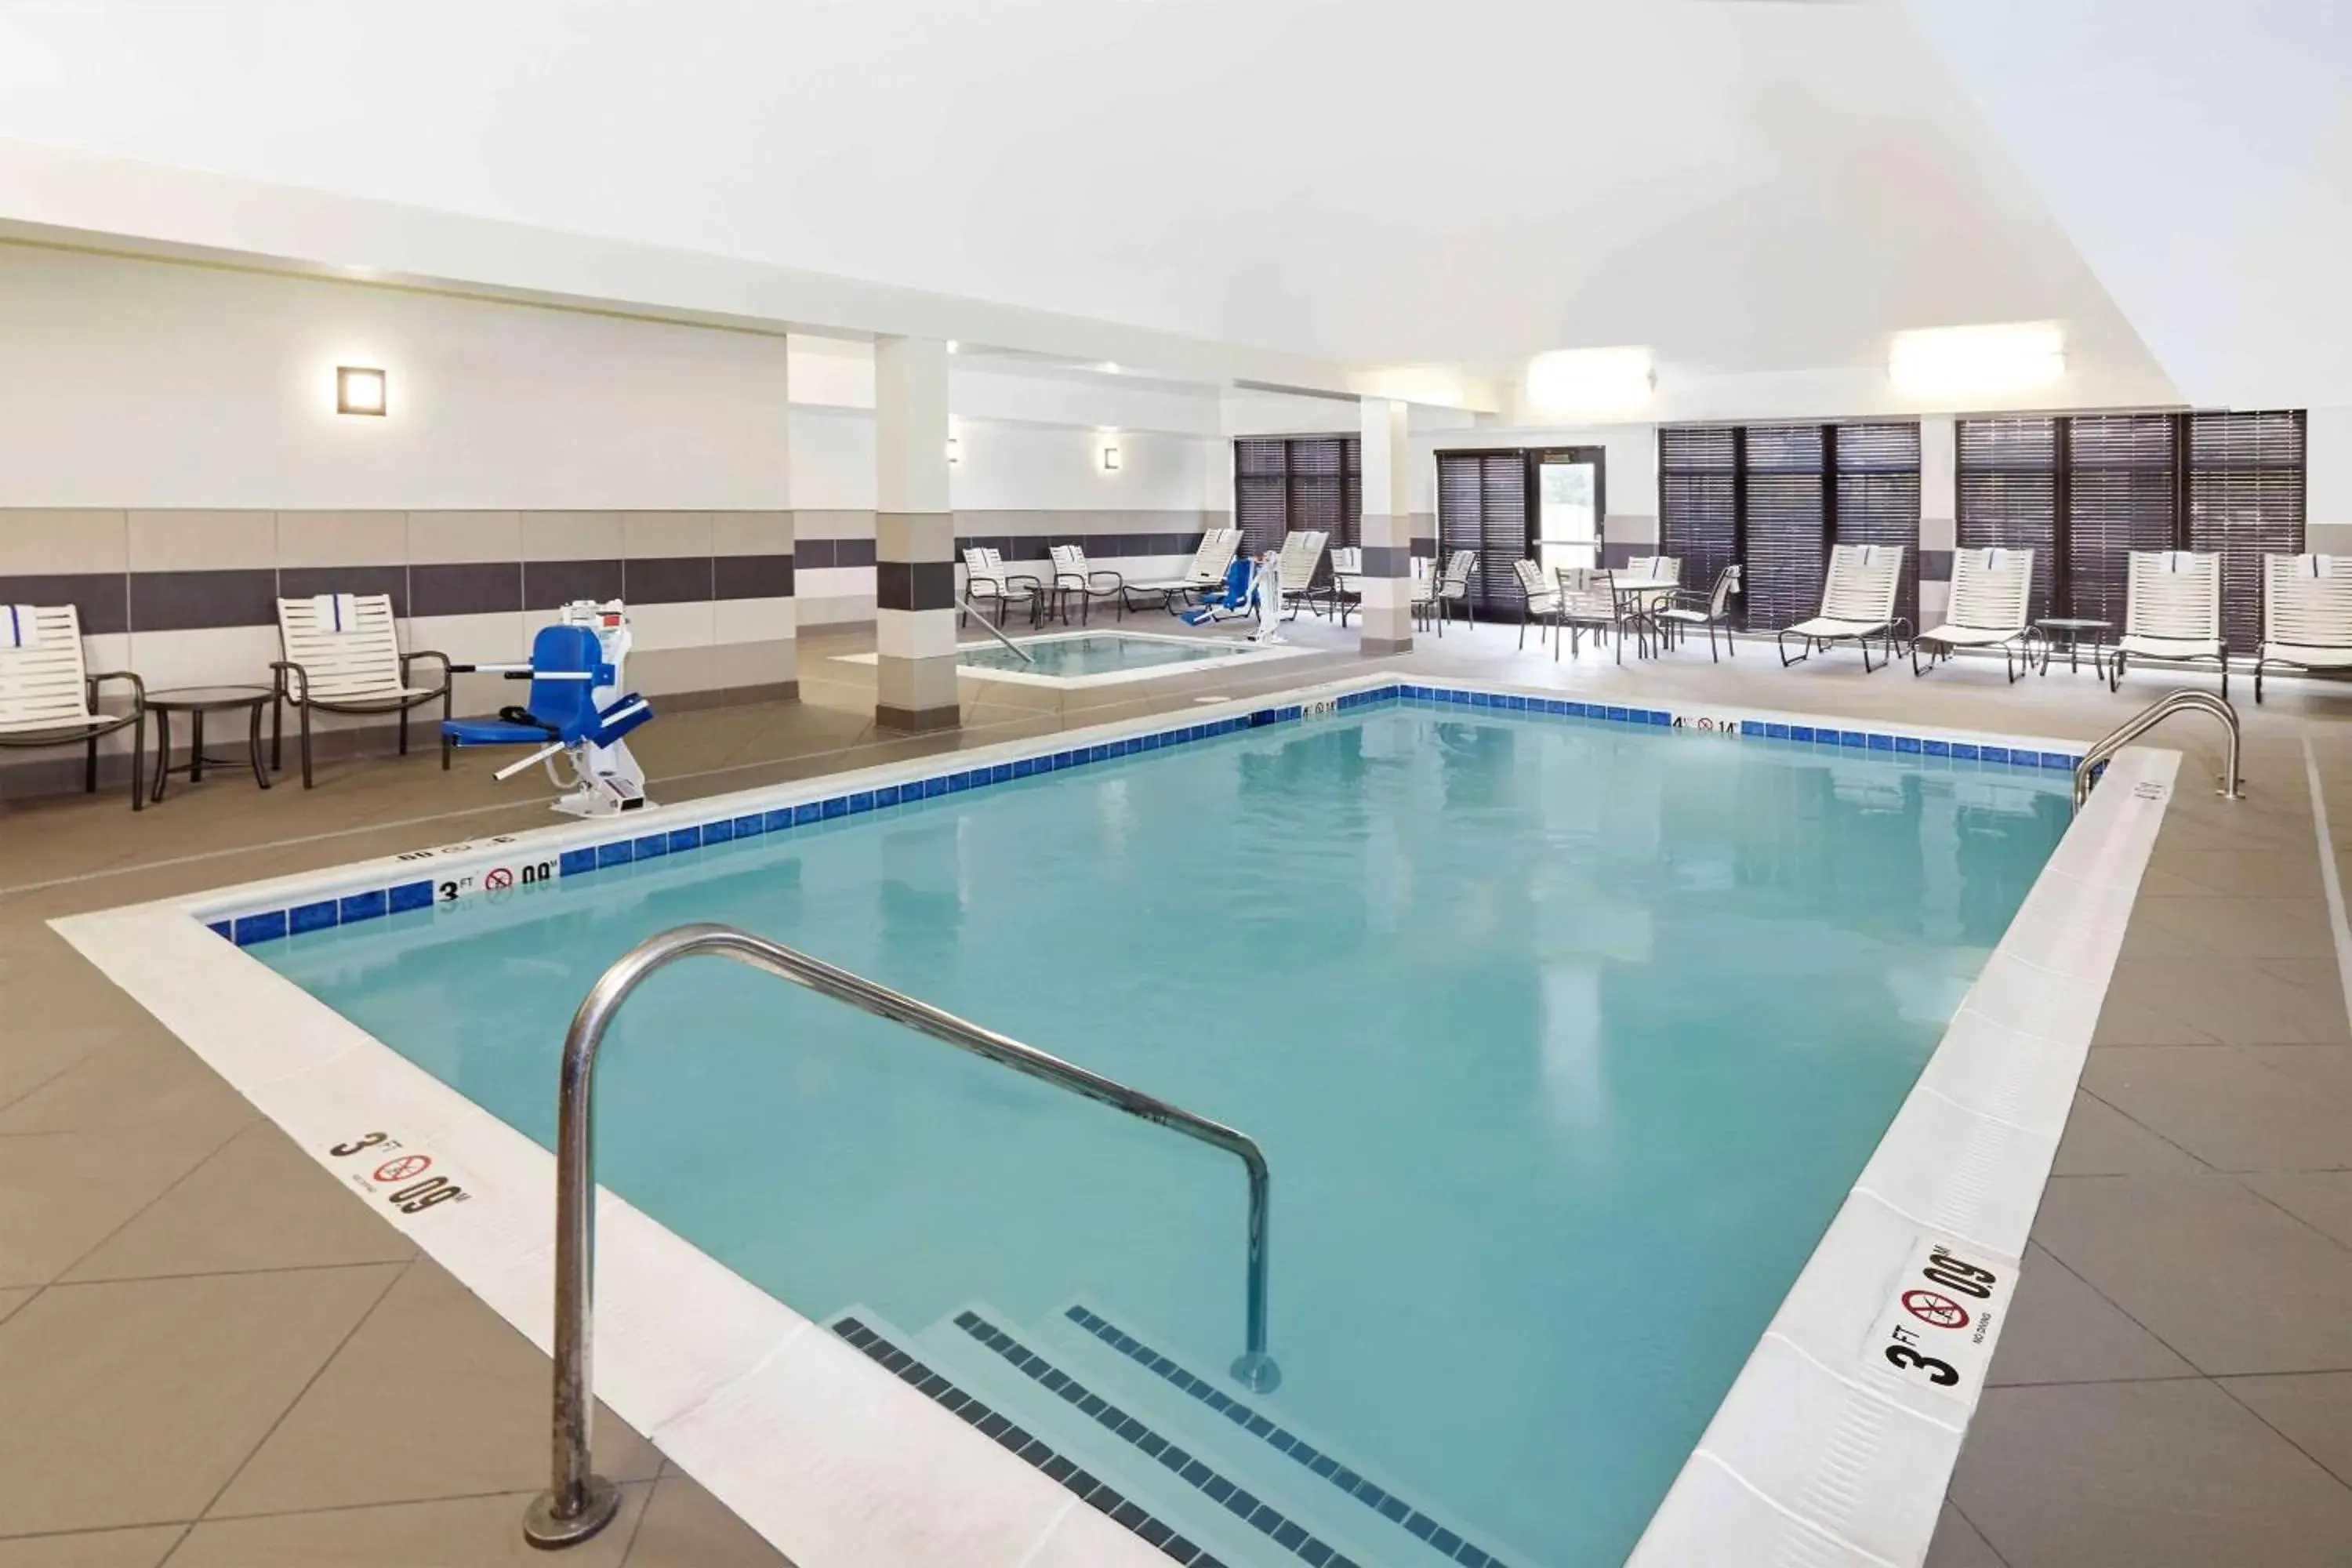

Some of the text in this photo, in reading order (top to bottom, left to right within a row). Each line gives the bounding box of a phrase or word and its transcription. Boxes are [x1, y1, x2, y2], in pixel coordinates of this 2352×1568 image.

[439, 881, 459, 902] 3
[330, 1131, 388, 1157] 3
[1892, 1324, 1920, 1346] FT
[1885, 1345, 1959, 1386] 3
